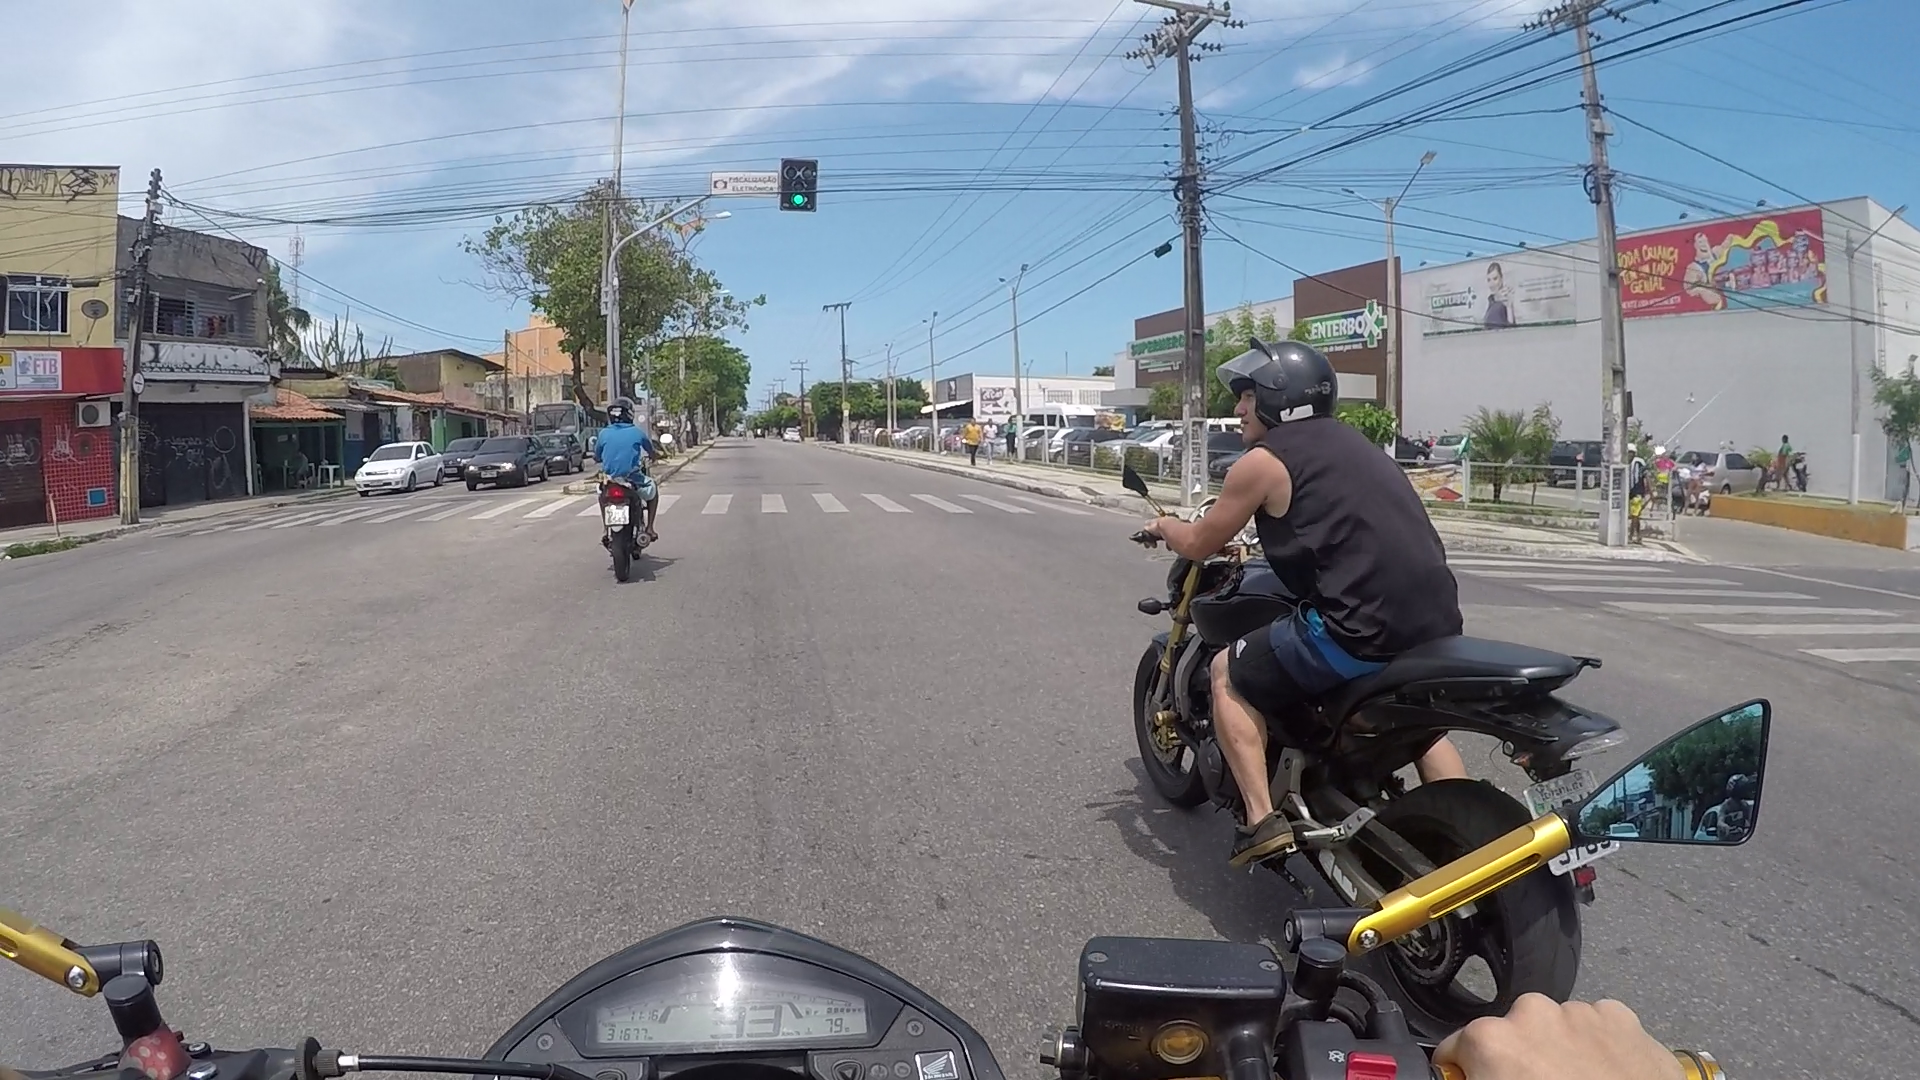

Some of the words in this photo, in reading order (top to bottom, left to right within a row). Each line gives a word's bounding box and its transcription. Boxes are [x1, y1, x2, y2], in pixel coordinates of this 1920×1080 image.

[729, 176, 776, 184] FISCALIZAÇÃO
[1630, 277, 1666, 294] GENIAL
[34, 358, 58, 375] FTB
[825, 1017, 843, 1033] 79
